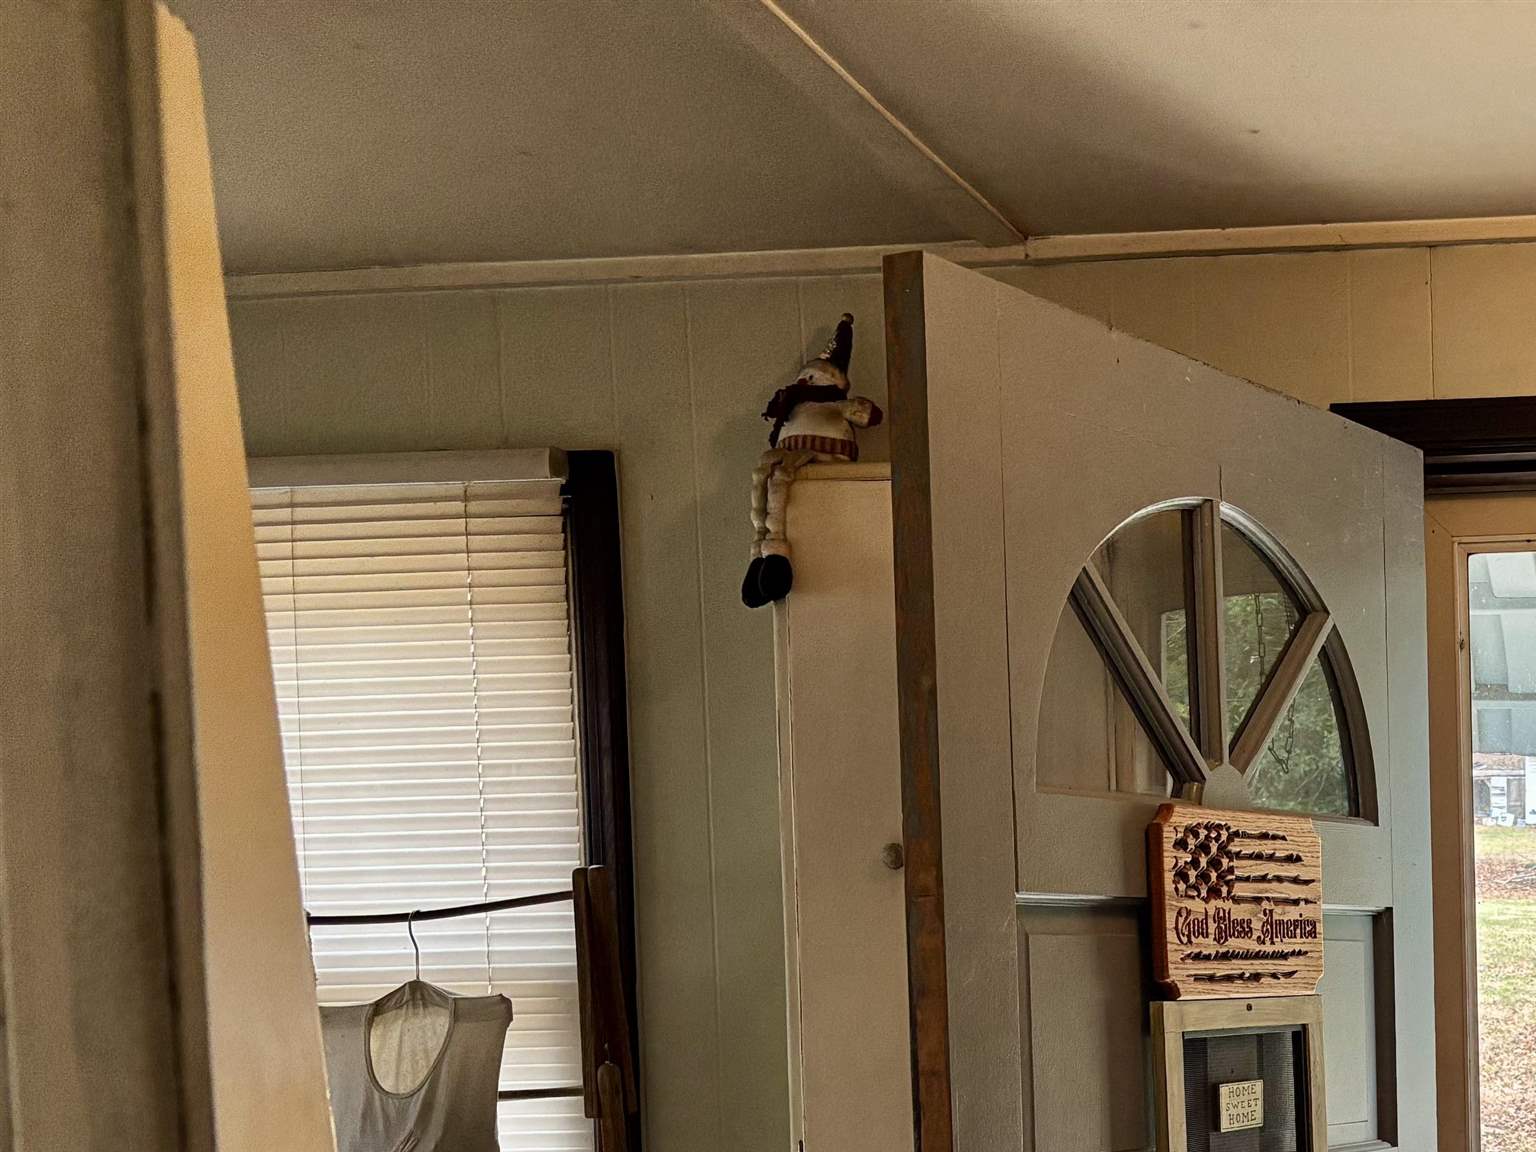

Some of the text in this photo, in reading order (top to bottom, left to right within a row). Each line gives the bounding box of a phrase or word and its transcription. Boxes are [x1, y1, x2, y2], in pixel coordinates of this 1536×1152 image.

[1174, 906, 1318, 946] God Bless America
[1228, 1084, 1257, 1098] HOME
[1226, 1097, 1260, 1112] SWEET
[1228, 1110, 1257, 1126] HOME
